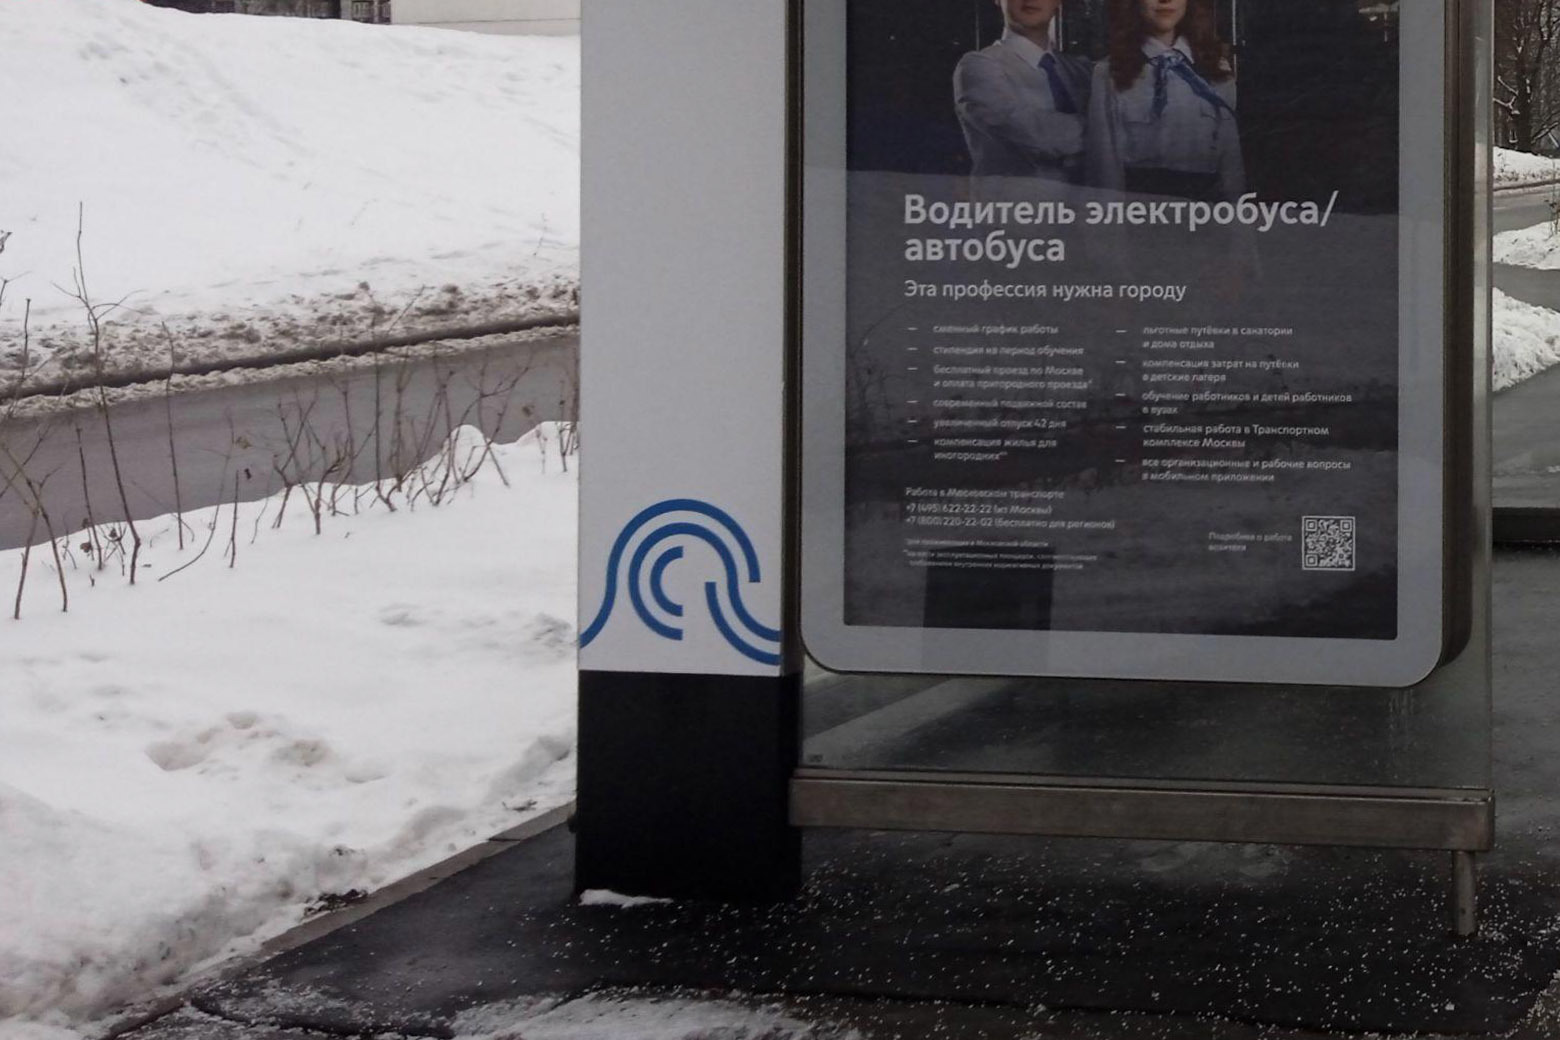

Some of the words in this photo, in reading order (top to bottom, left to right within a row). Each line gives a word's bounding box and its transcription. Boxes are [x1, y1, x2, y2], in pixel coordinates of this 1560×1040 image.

[904, 195, 1076, 228] Водитель
[1085, 190, 1339, 232] электробуса/
[904, 230, 1065, 269] автобуса
[904, 280, 937, 297] Эта
[942, 280, 1047, 301] профессия
[1052, 284, 1113, 300] нужна
[1119, 284, 1187, 302] городу
[982, 325, 1017, 335] график
[1020, 324, 1058, 335] работы
[1143, 327, 1189, 335] льготные
[1191, 326, 1231, 337] путёвки
[1240, 327, 1293, 337] санатории
[1150, 341, 1177, 349] дома
[1179, 340, 1215, 350] отдыха
[1000, 347, 1035, 357] период
[1037, 345, 1084, 357] обучения
[933, 364, 991, 375] бесплатный
[993, 366, 1029, 376] проезд
[1031, 367, 1042, 375] по
[1044, 366, 1084, 376] Москве
[1142, 360, 1209, 370] компенсация
[1211, 361, 1243, 370] затрат
[1259, 360, 1300, 370] путёвки
[1150, 374, 1189, 383] детские
[1191, 373, 1227, 383] лагеря
[942, 380, 975, 388] оплата
[977, 380, 1045, 390] пригородного
[1142, 390, 1190, 402] обучение
[1192, 390, 1251, 402] работников
[1253, 393, 1260, 401] и
[1261, 392, 1290, 402] детей
[1291, 392, 1352, 403] работников
[1055, 400, 1087, 409] состав
[1150, 406, 1178, 416] вузах
[1000, 421, 1033, 430] отпуск
[1034, 419, 1047, 428] 42
[1049, 421, 1066, 429] дня
[1143, 423, 1203, 434] стабильная
[1205, 424, 1242, 435] работа
[1252, 424, 1330, 437] Транспортном
[934, 438, 1001, 448] компенсация
[1004, 439, 1036, 447] жилья
[1037, 439, 1057, 448] для
[1142, 438, 1200, 448] комплексе
[1201, 438, 1246, 448] Москвы
[1142, 459, 1159, 467] все
[1160, 459, 1250, 469] организационные
[1261, 459, 1305, 470] рабочие
[1307, 461, 1351, 471] вопросы
[1150, 472, 1209, 481] мобильном
[1211, 473, 1275, 482] приложении
[1010, 491, 1065, 500] транспорте
[942, 504, 992, 514] 622-22-22
[1009, 505, 1052, 515] Москвы)
